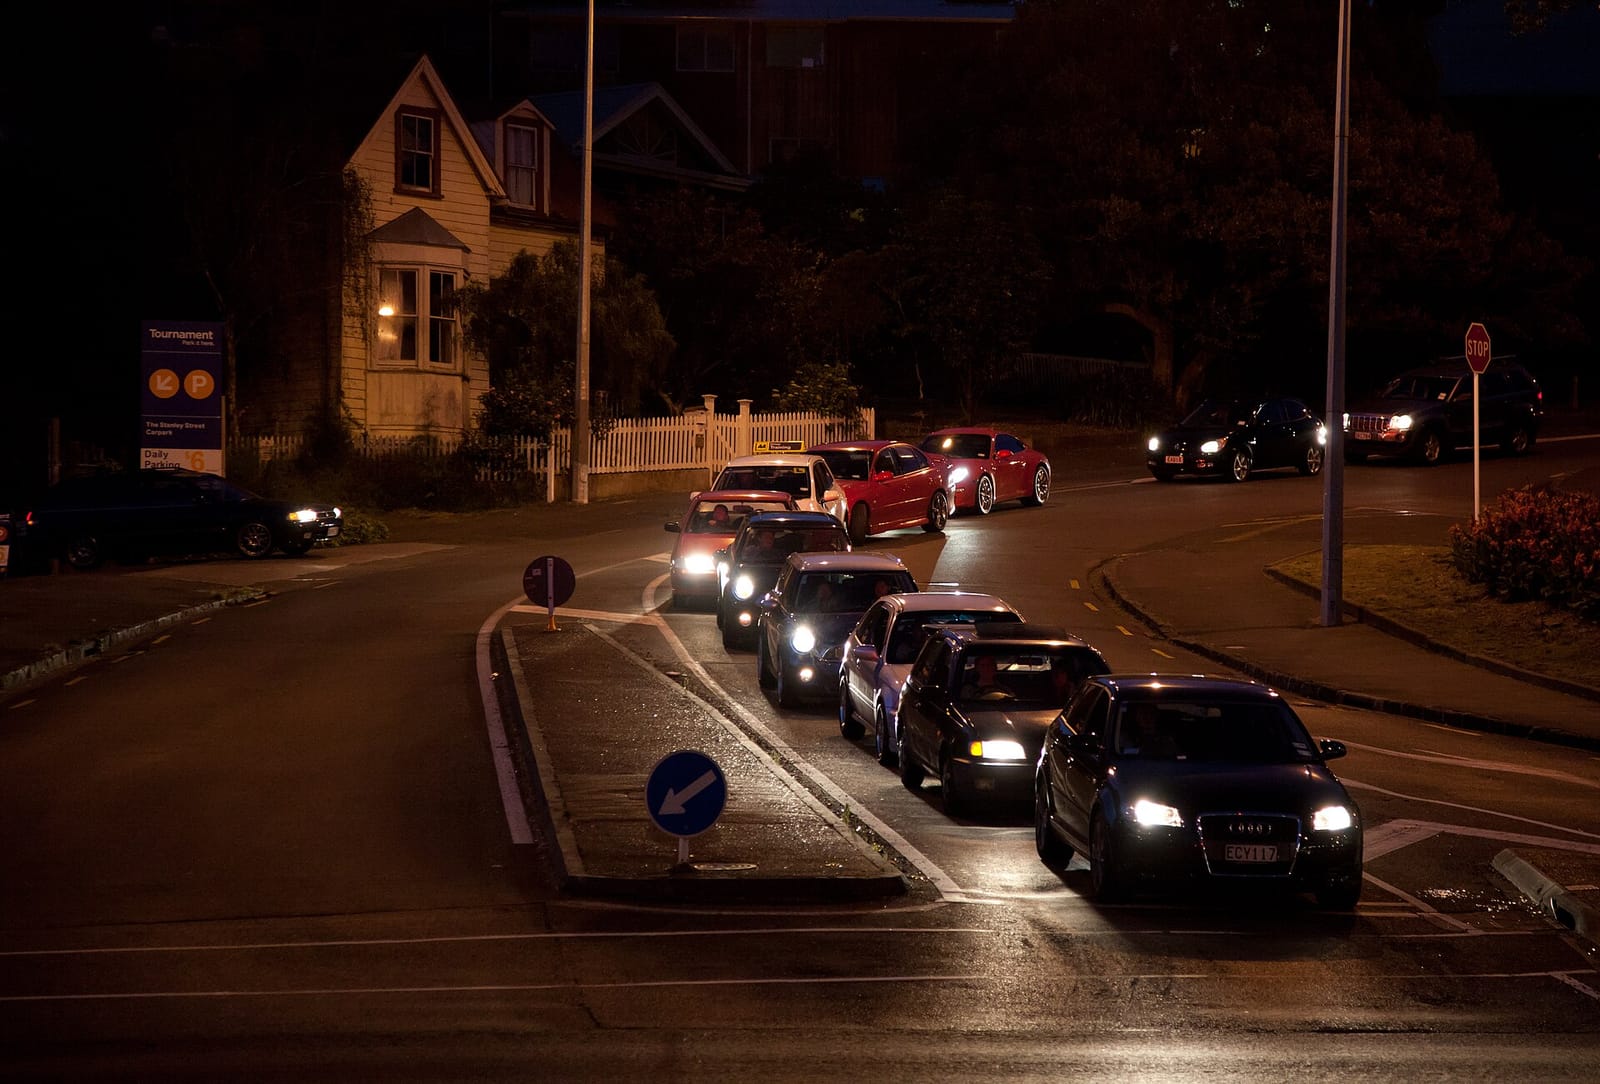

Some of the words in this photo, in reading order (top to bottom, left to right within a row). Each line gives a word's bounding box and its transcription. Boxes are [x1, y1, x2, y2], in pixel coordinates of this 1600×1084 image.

[149, 329, 214, 339] Tournament
[1468, 339, 1488, 357] STOP
[192, 375, 207, 393] P
[160, 422, 184, 430] Stanley
[145, 450, 168, 459] Daily
[145, 460, 180, 469] Parking
[1227, 846, 1276, 860] ECY117
